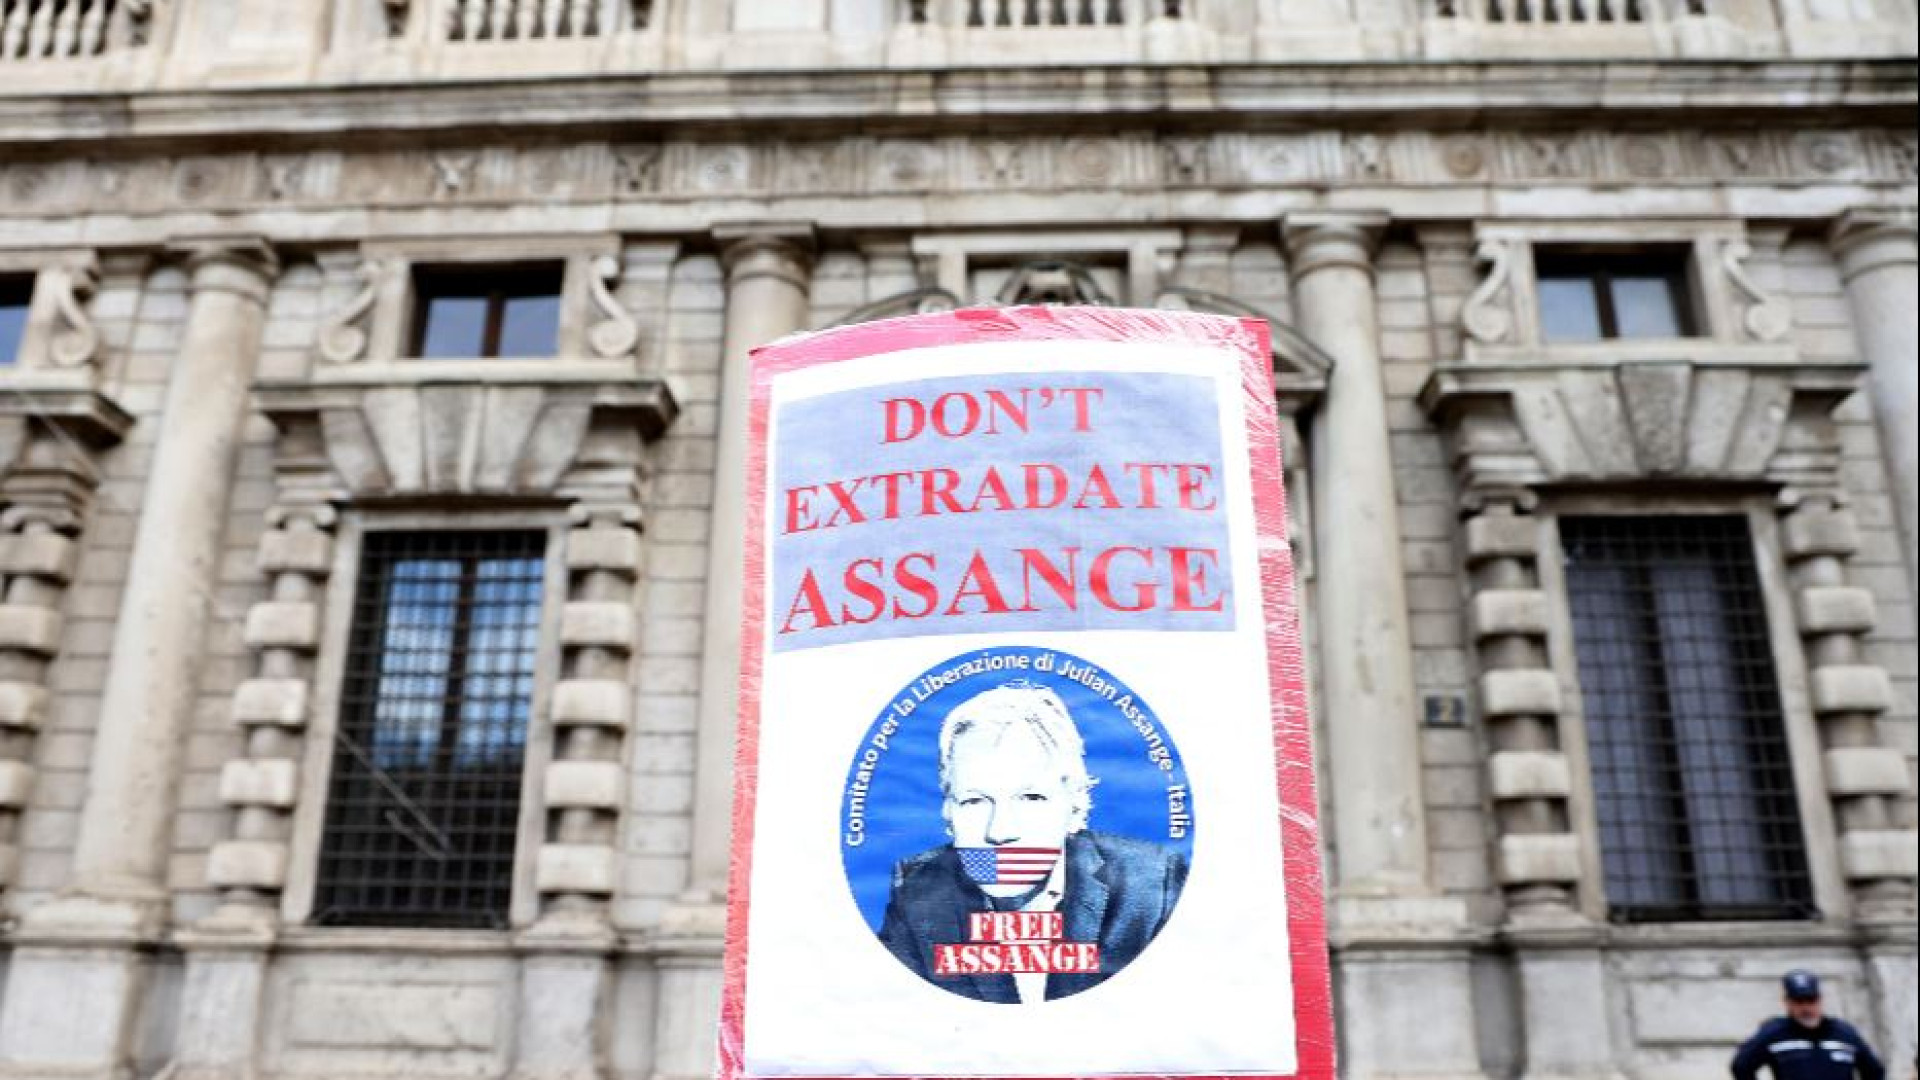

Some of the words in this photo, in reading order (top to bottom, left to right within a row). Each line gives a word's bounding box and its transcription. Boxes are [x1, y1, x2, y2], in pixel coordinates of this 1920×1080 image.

[879, 388, 1104, 445] DON’T
[781, 461, 1217, 535] EXTRADATE
[778, 545, 1226, 634] ASSANGE
[845, 748, 879, 847] Comitato
[872, 713, 900, 751] per
[892, 697, 917, 717] la
[911, 651, 1029, 702] Liberazione
[1033, 653, 1055, 672] di
[1057, 659, 1118, 700] Julian
[1113, 694, 1174, 771] Assange
[1167, 785, 1191, 839] Italia
[935, 943, 1100, 974] ASSANGE
[970, 912, 1063, 941] FREE
